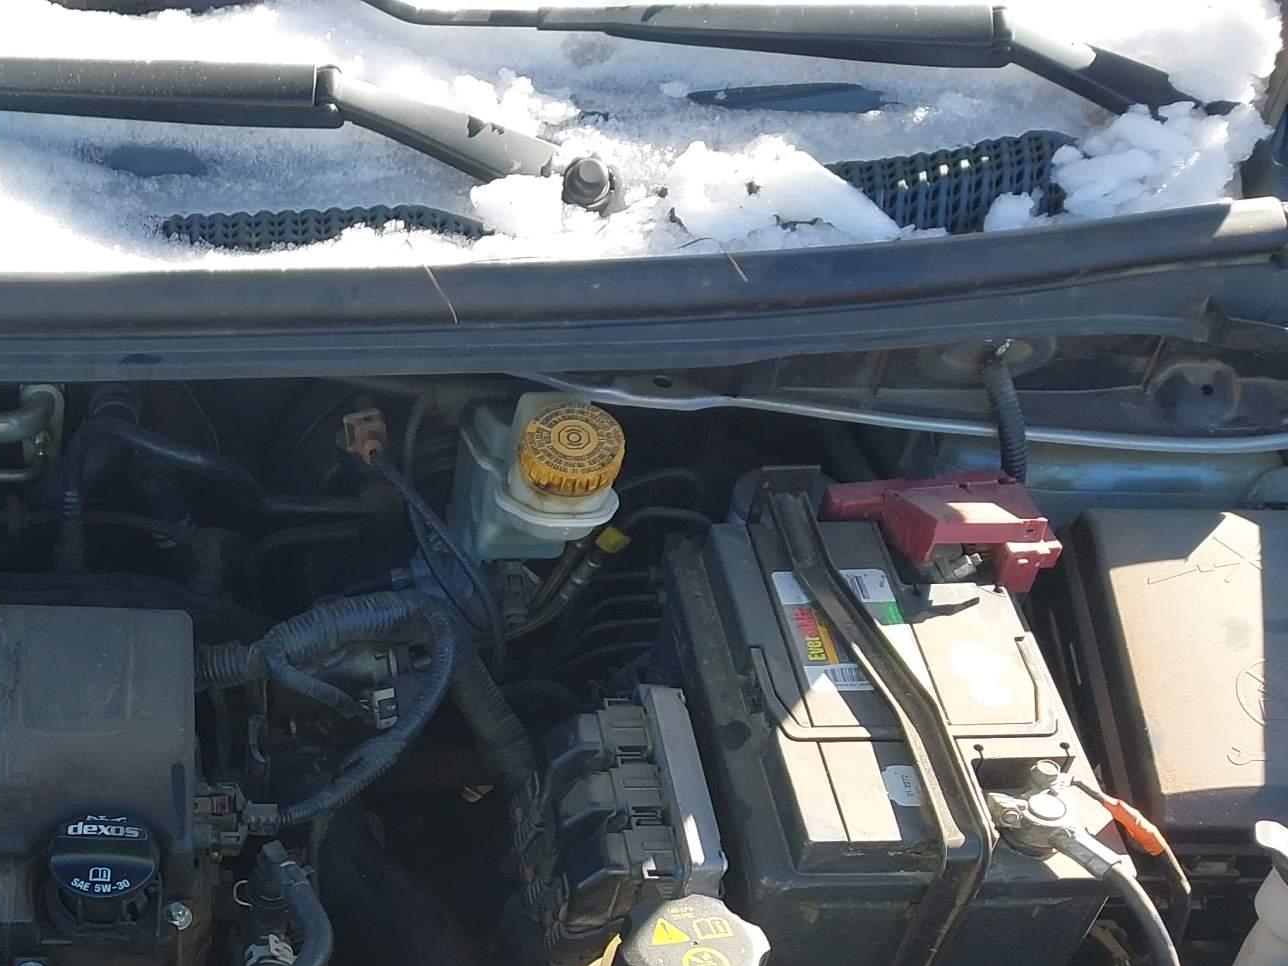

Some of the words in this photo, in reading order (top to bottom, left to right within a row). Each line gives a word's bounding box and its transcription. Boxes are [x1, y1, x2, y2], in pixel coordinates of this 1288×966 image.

[67, 821, 143, 838] dexos
[70, 877, 91, 892] SAE
[94, 879, 130, 893] 5W-30
